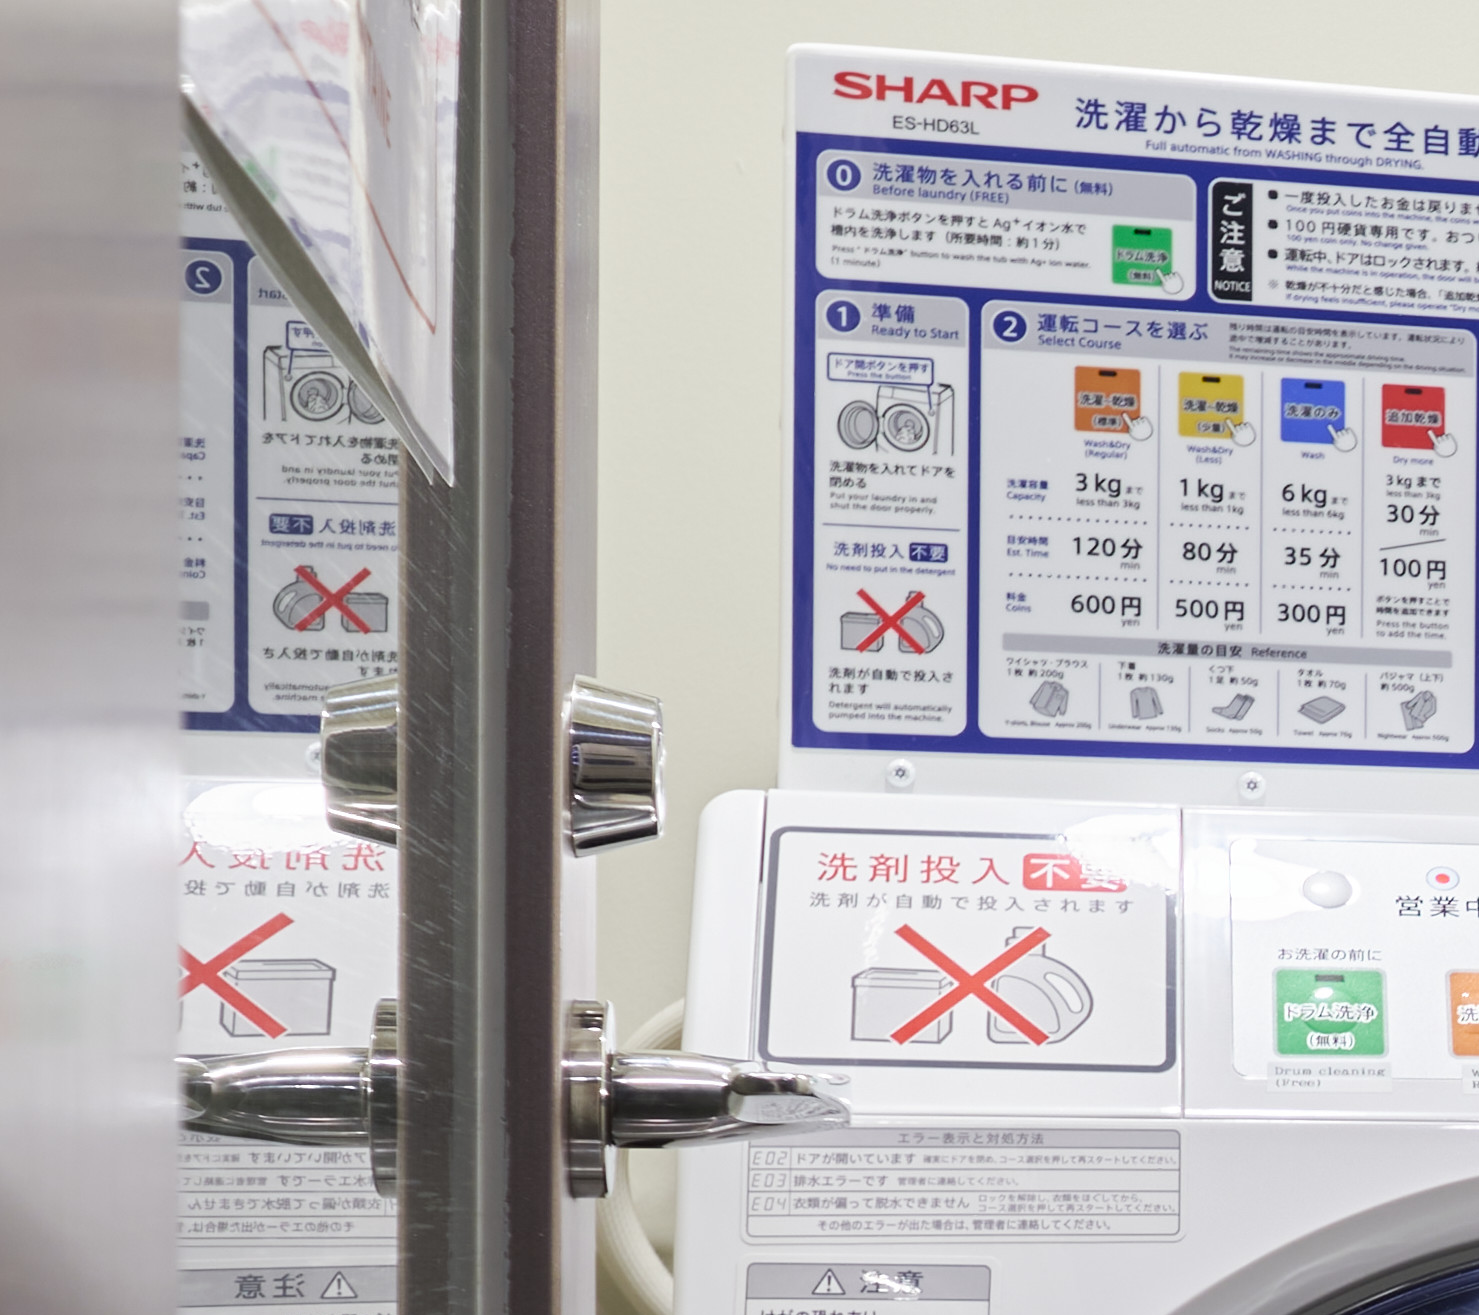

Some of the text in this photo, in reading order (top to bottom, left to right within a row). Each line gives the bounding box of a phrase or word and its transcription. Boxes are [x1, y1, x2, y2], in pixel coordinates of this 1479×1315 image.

[832, 71, 1039, 111] SHARP
[892, 114, 980, 136] ES-HD63L
[872, 163, 1068, 194] 洗濯物を入れる前に
[1220, 192, 1245, 273] ご注意
[1214, 279, 1251, 293] NOTICE
[872, 303, 915, 324] 準備
[871, 325, 959, 340] Ready to Start
[1038, 313, 1209, 341] 運転コースを選ぶ
[1038, 335, 1121, 350] Select Course
[1285, 404, 1340, 420] 洗濯のみ
[1386, 410, 1440, 426] 追加乾燥
[830, 462, 955, 478] 洗濯物を入れてドアを
[829, 476, 867, 489] 閉める
[833, 541, 947, 560] 洗剤投入 不要
[1158, 643, 1307, 659] 洗濯量の目安 Reference
[828, 667, 953, 683] 洗剤が自動で投入さ
[828, 683, 868, 695] れます
[818, 852, 1010, 886] 洗剤投入
[809, 891, 1134, 914] 洗剤が自動で投入されます
[1283, 1004, 1376, 1022] ドラム洗浄
[897, 1132, 1044, 1146] エラー表示と対処方法
[795, 1152, 915, 1166] ドアが開いています
[793, 1174, 889, 1187] 排水エラーです
[793, 1197, 969, 1210] 衣類が偏って脱水できません
[817, 1219, 1112, 1231] その他のエラーが出た場合は、管理者に連絡してください。
